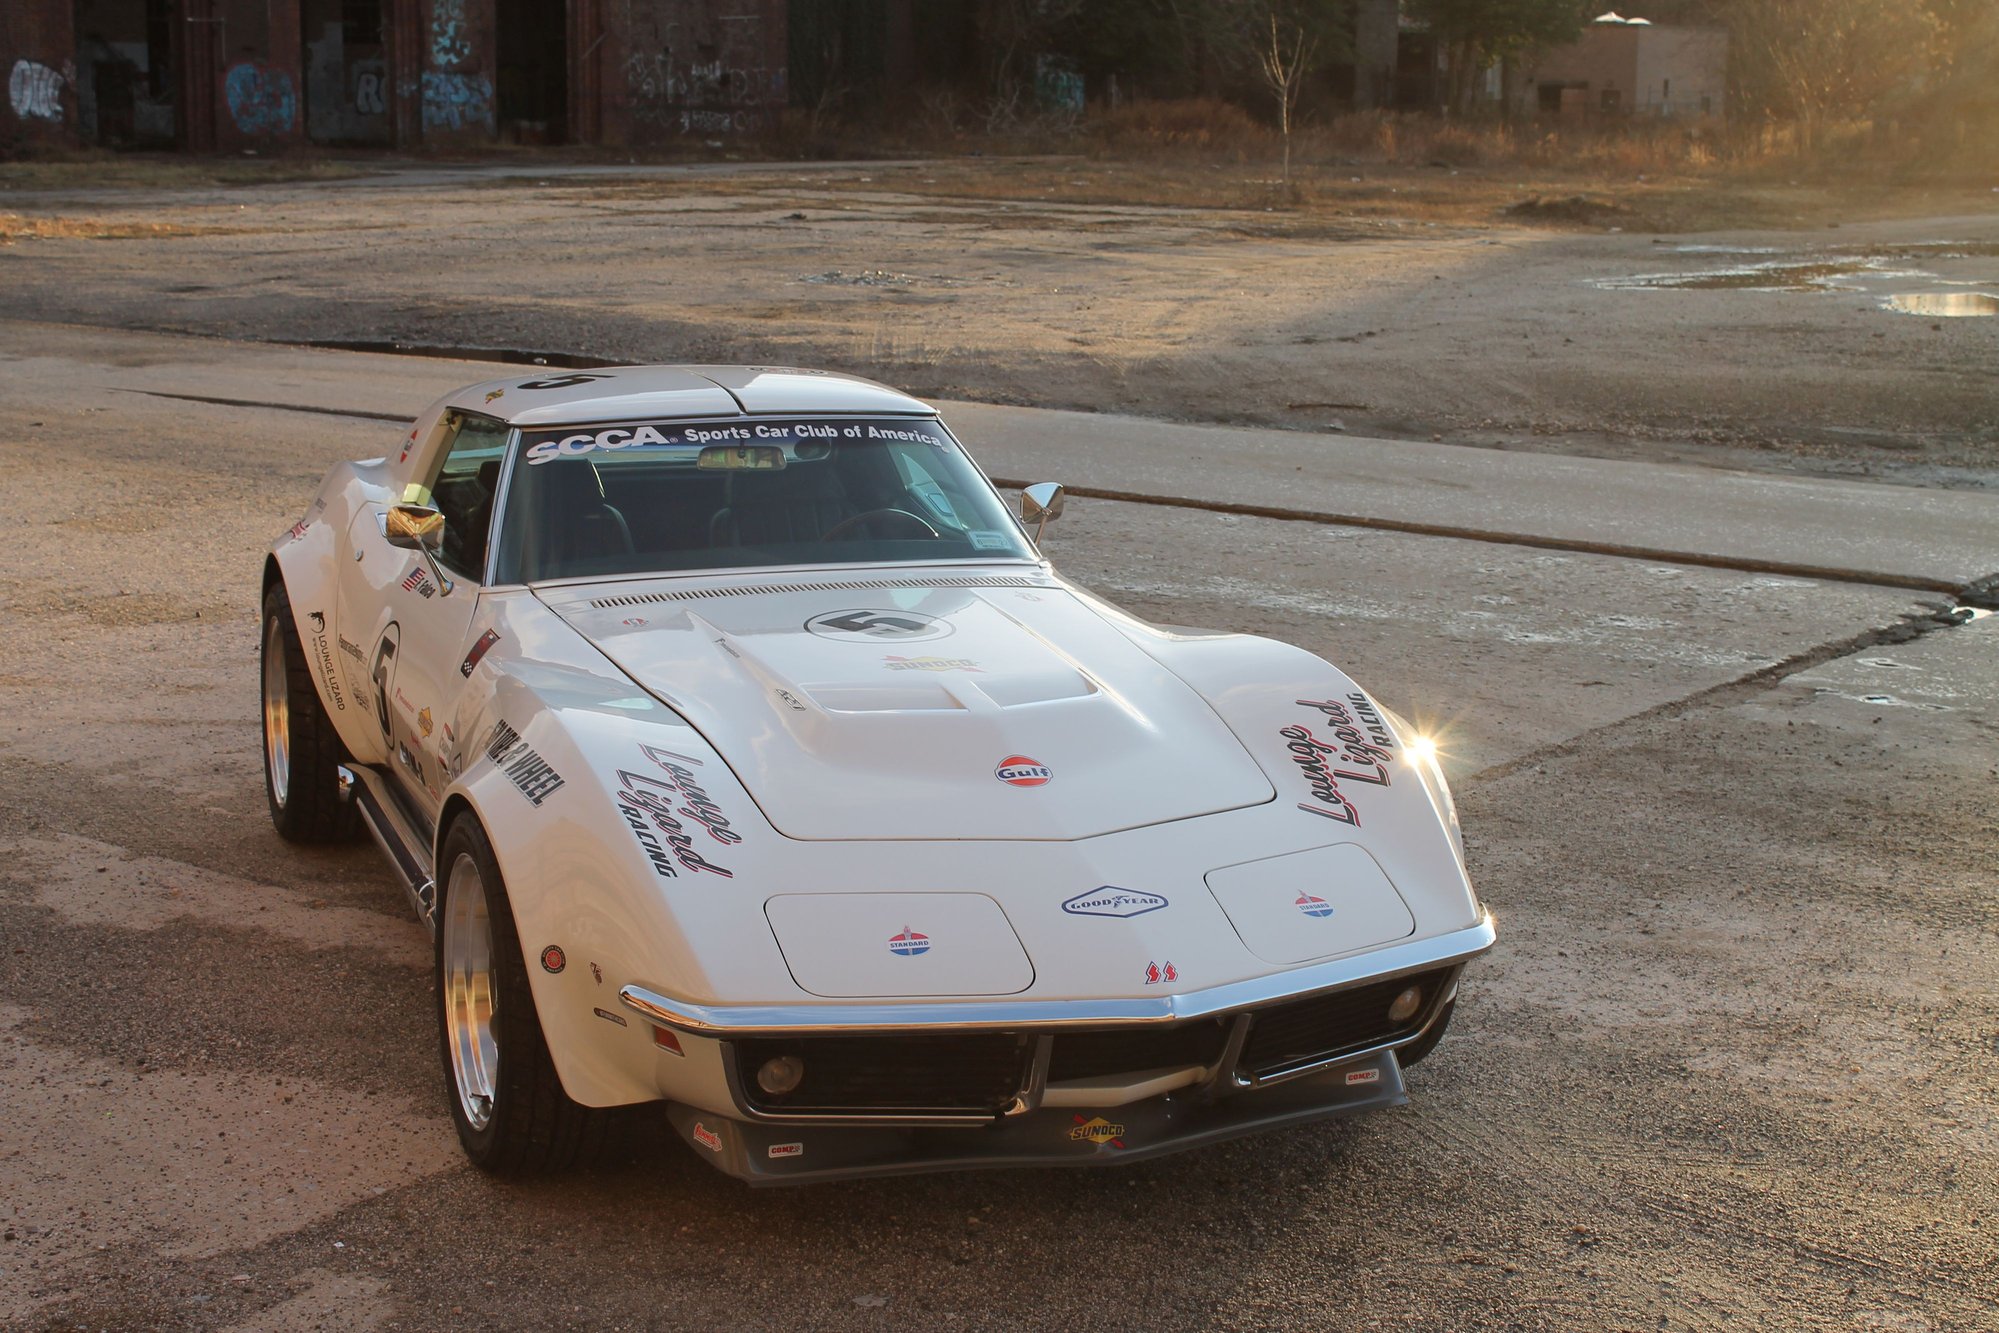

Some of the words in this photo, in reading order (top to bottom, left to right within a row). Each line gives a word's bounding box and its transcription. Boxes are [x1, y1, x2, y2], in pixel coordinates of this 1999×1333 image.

[526, 426, 670, 465] SCCA
[684, 427, 751, 443] Sports
[755, 425, 789, 438] Car
[794, 425, 838, 438] Club
[843, 425, 862, 438] of
[868, 426, 942, 447] America
[815, 611, 939, 638] 5
[319, 635, 335, 675] LOUNGE
[329, 676, 345, 711] LIZARD
[373, 635, 396, 737] 5
[884, 659, 977, 671] SUNOCO
[1296, 699, 1394, 788] Lizard
[1346, 692, 1394, 748] RACING
[504, 750, 566, 806] WHEEL
[638, 742, 743, 845] Lounge
[998, 767, 1048, 779] Gulf
[1279, 724, 1362, 828] Lounge
[616, 768, 734, 879] Lizard
[618, 803, 678, 879] RACING
[1071, 896, 1159, 909] GOODYEAR
[890, 940, 929, 949] STANDARD
[1072, 1125, 1122, 1139] SUNOCO
